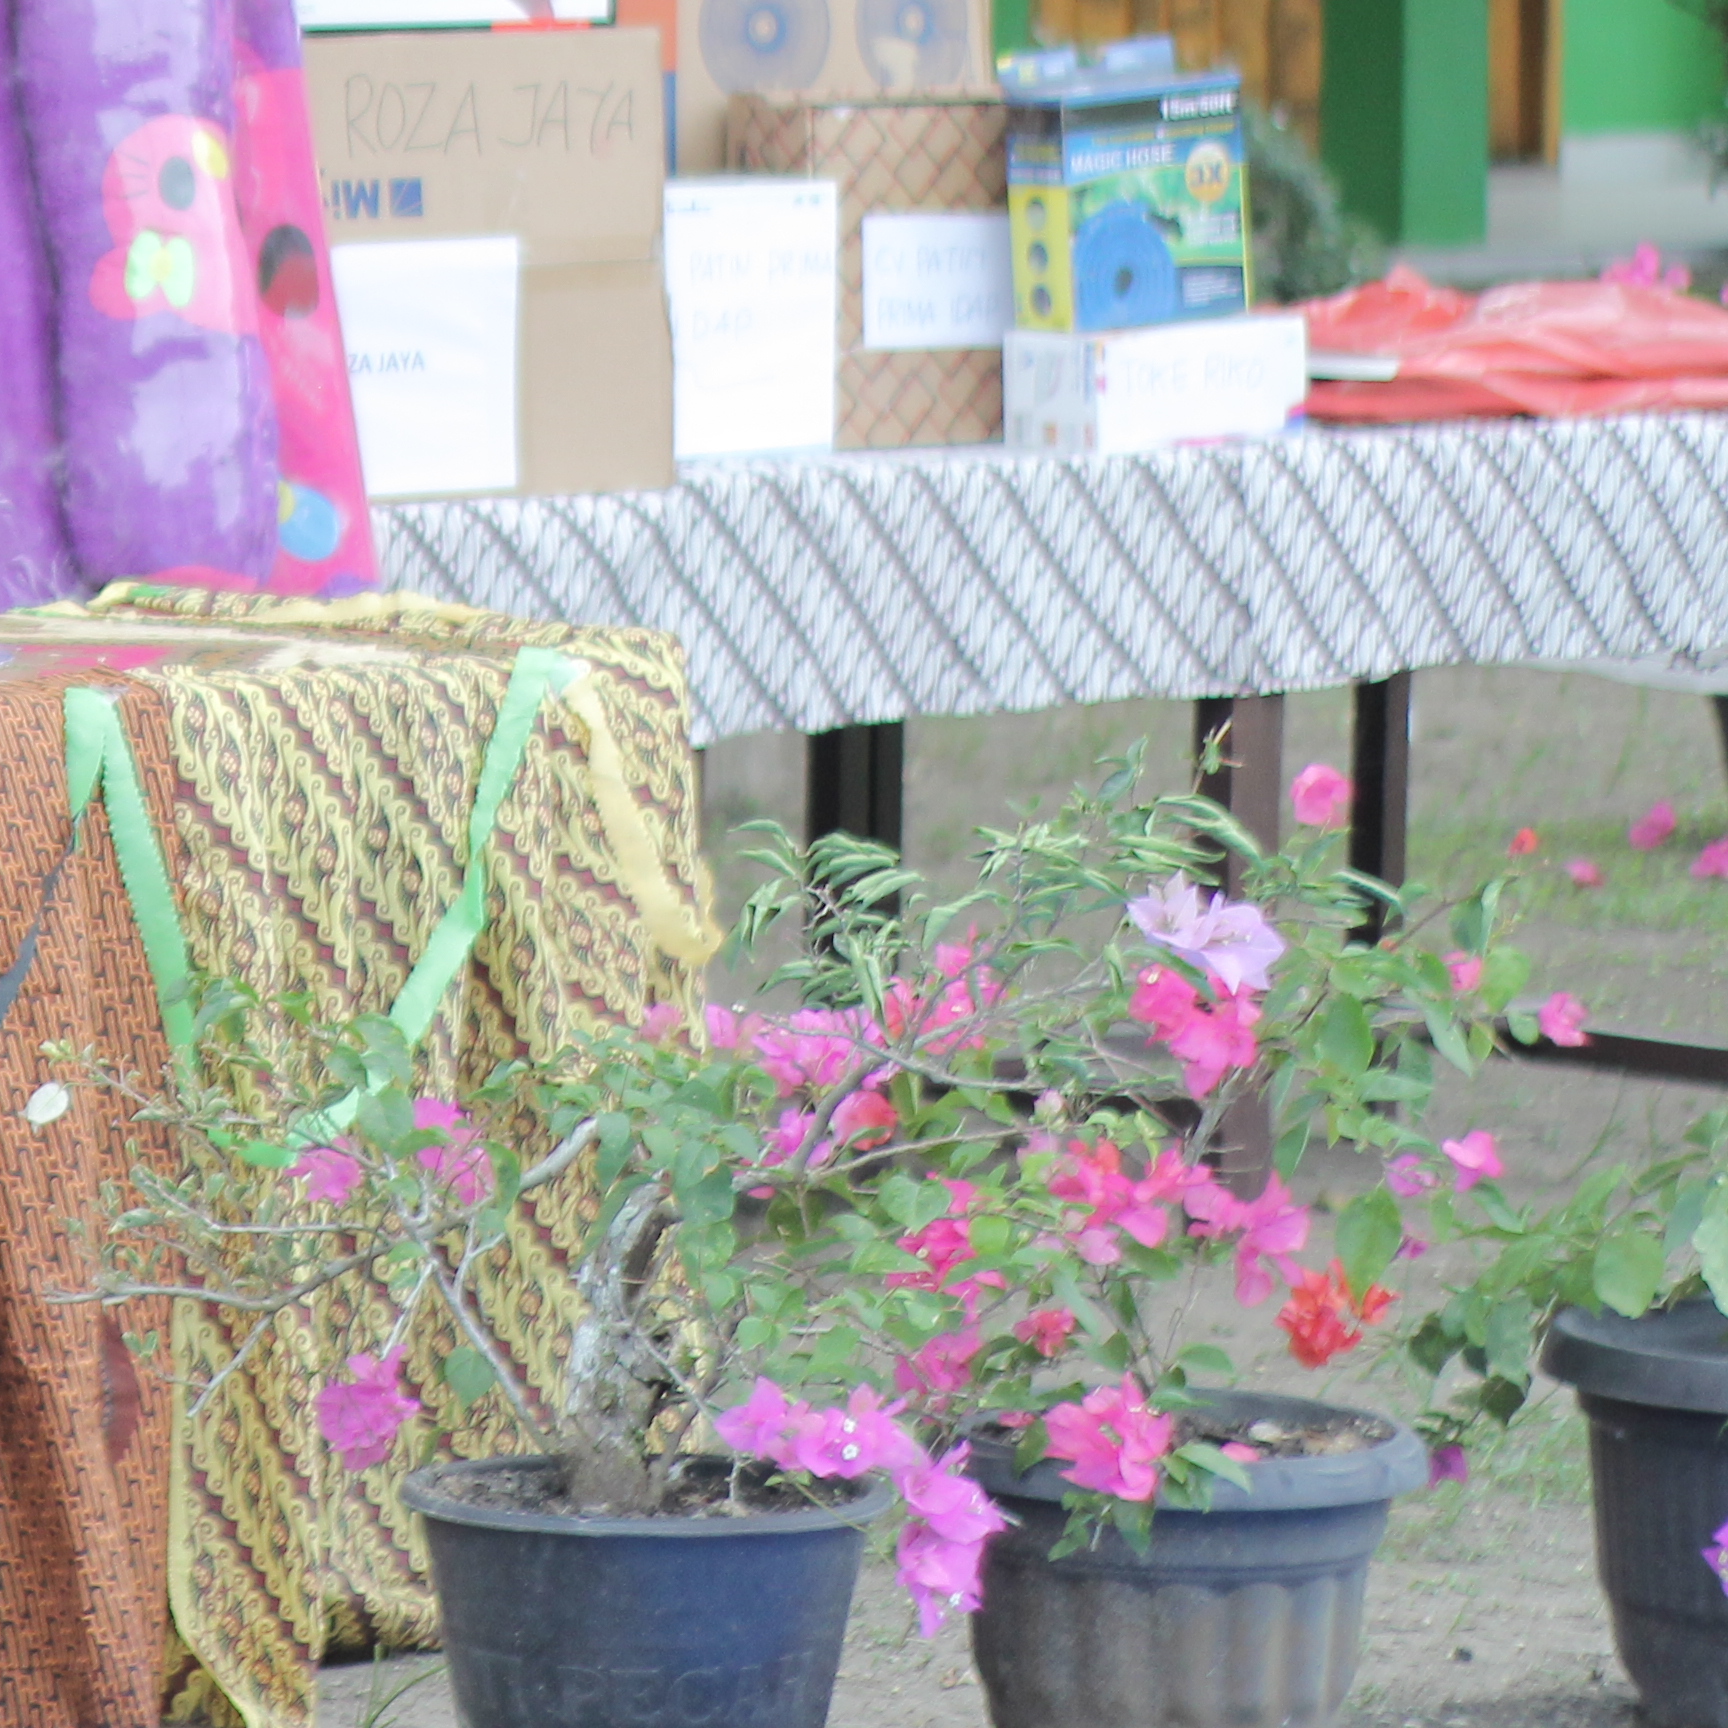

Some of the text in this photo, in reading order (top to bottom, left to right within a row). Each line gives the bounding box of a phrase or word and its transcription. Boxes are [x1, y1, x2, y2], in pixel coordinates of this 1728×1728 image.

[343, 73, 634, 160] ROZA JAYA
[1071, 150, 1117, 175] MAGIC
[1125, 143, 1174, 169] HOSE
[379, 350, 426, 374] JAYA
